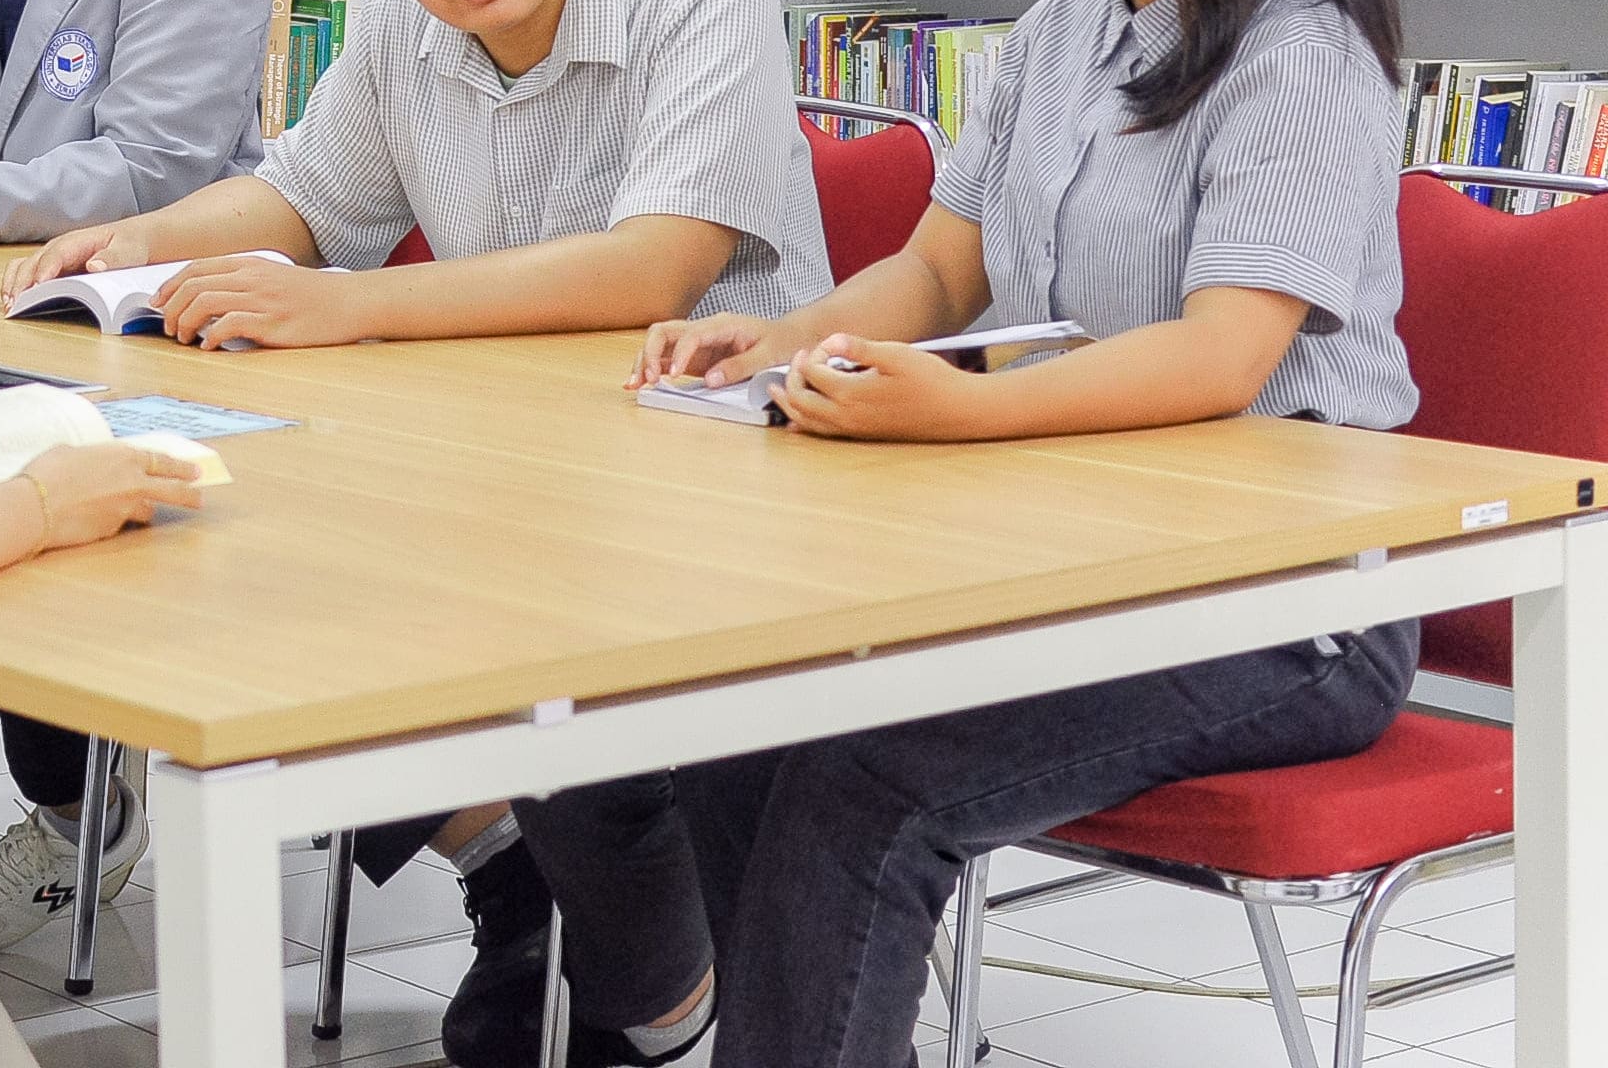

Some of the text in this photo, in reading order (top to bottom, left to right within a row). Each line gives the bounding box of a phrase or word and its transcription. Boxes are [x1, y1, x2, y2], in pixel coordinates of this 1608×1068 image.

[274, 54, 285, 124] Theory of Strategic
